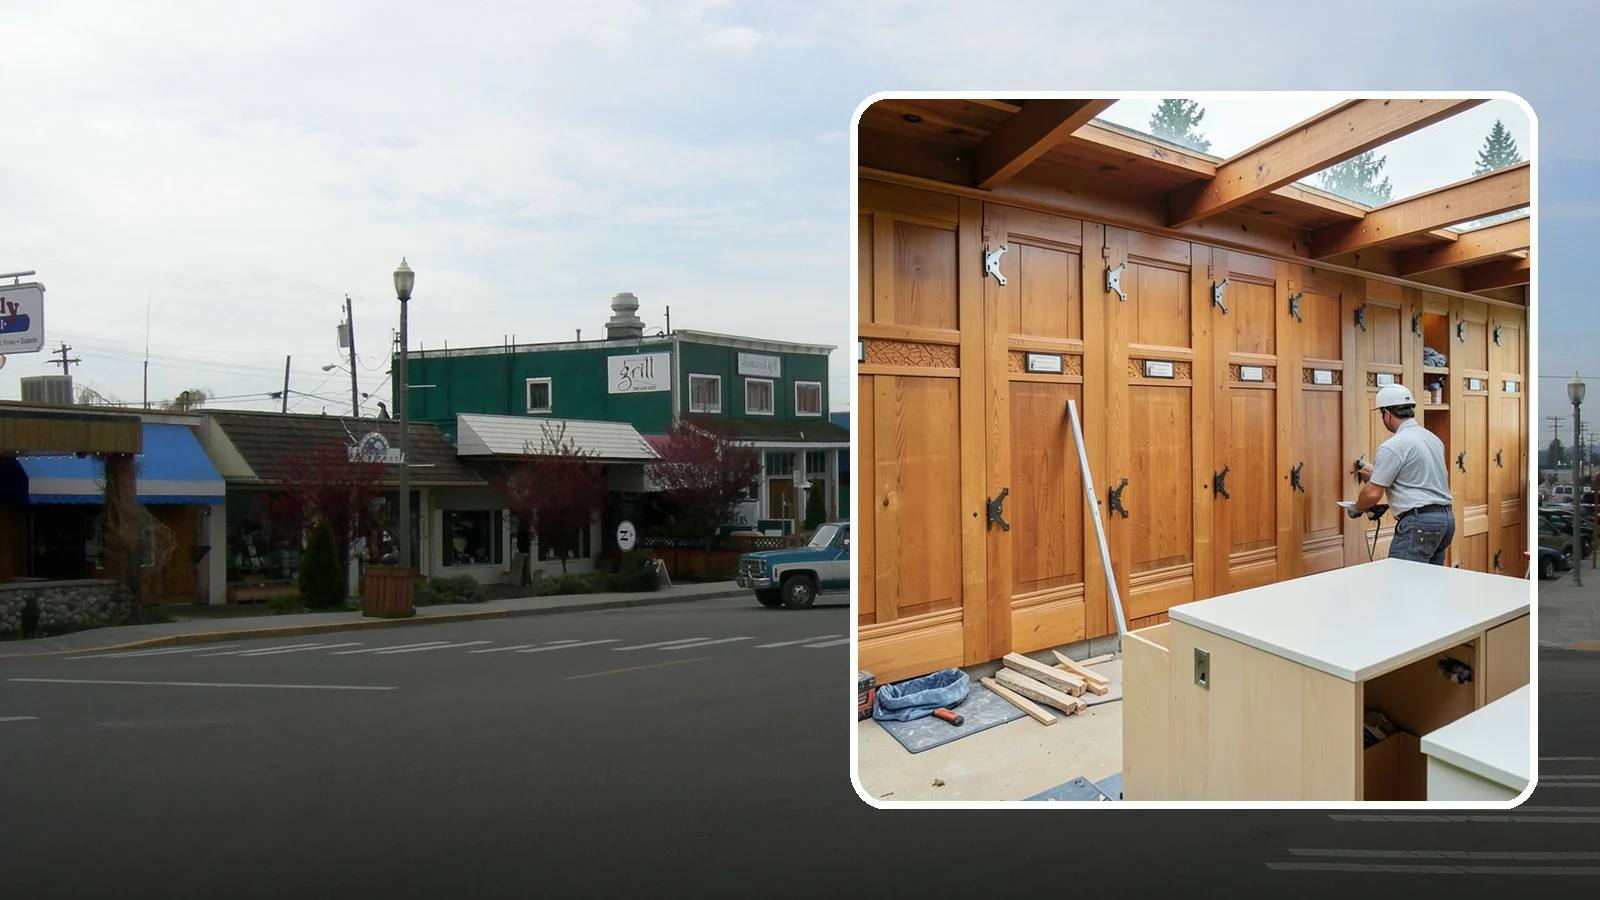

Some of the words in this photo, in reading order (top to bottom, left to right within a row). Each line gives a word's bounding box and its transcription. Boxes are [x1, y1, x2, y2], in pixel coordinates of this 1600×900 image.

[3, 338, 16, 346] Fries
[20, 337, 38, 345] Salads
[617, 356, 655, 391] grill
